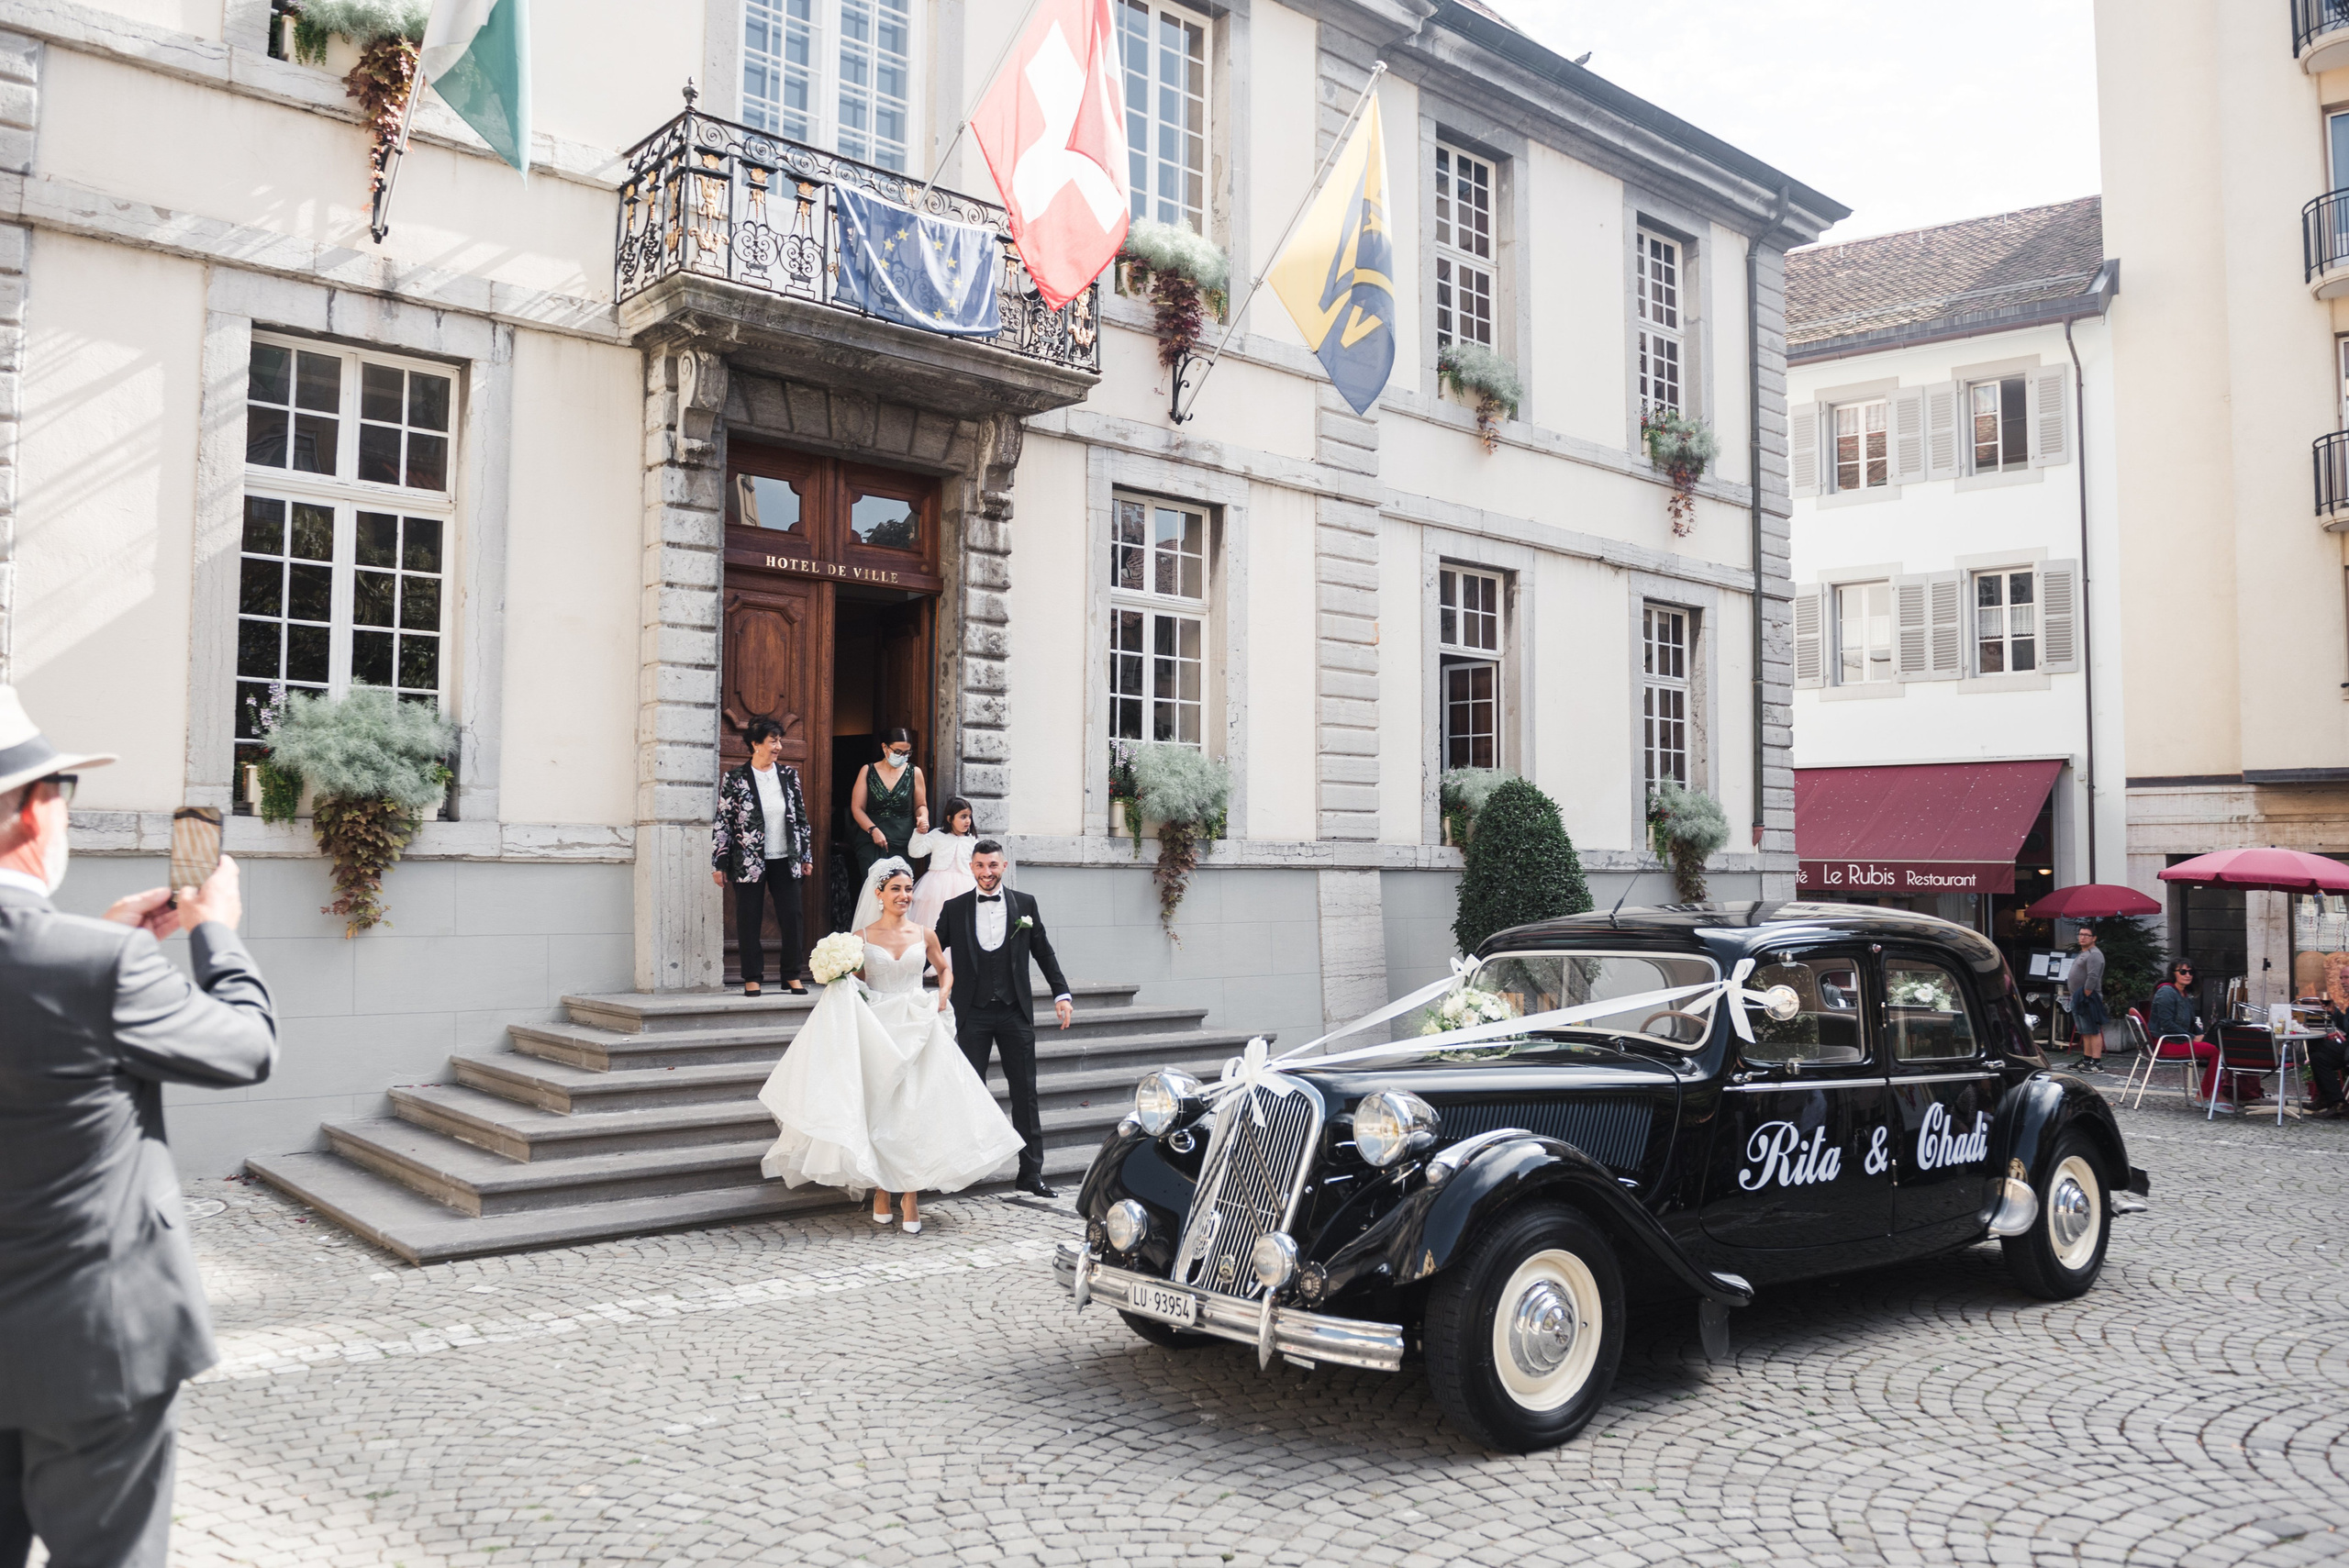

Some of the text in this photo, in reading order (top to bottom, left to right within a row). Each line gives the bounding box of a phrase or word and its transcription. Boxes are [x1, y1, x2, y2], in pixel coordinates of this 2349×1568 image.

[765, 555, 898, 584] HOTEL DE VILLE
[1823, 863, 1842, 884] Le
[1847, 864, 1896, 885] Rubis
[1906, 870, 1976, 886] Restaurant
[1738, 1102, 1988, 1191] Rita & Chadi
